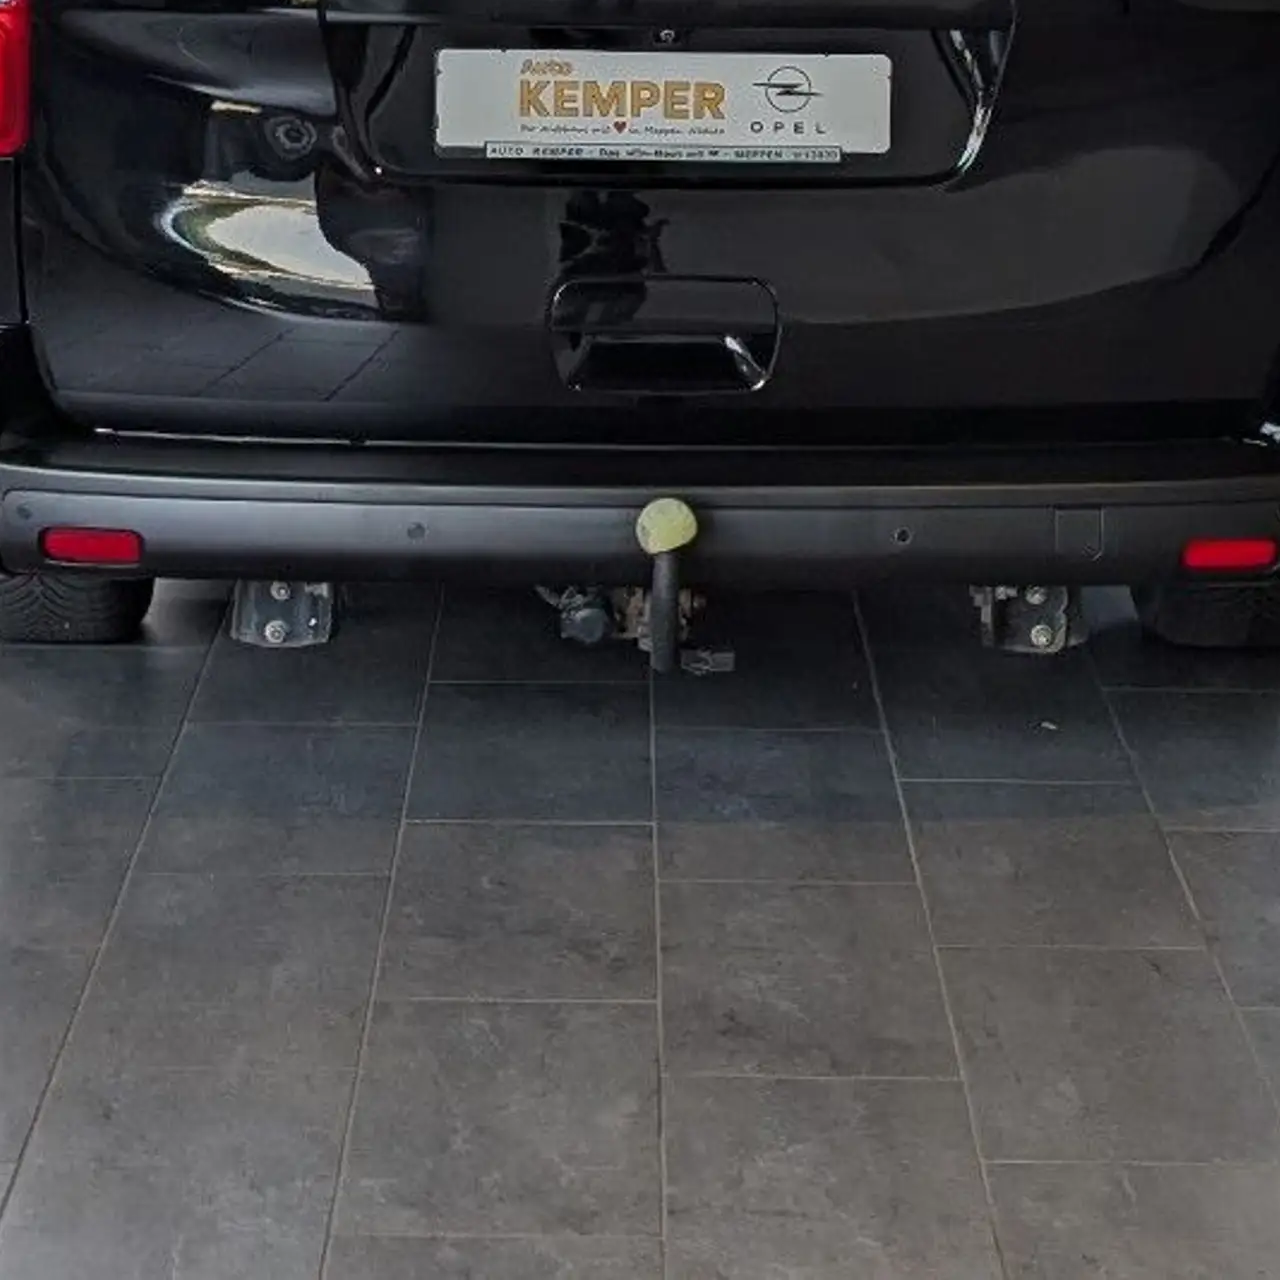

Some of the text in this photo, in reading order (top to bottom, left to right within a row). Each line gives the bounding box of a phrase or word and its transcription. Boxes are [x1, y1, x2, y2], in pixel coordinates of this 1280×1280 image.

[520, 58, 573, 76] Auto
[519, 80, 726, 120] KEMPER
[750, 121, 827, 134] OPEL
